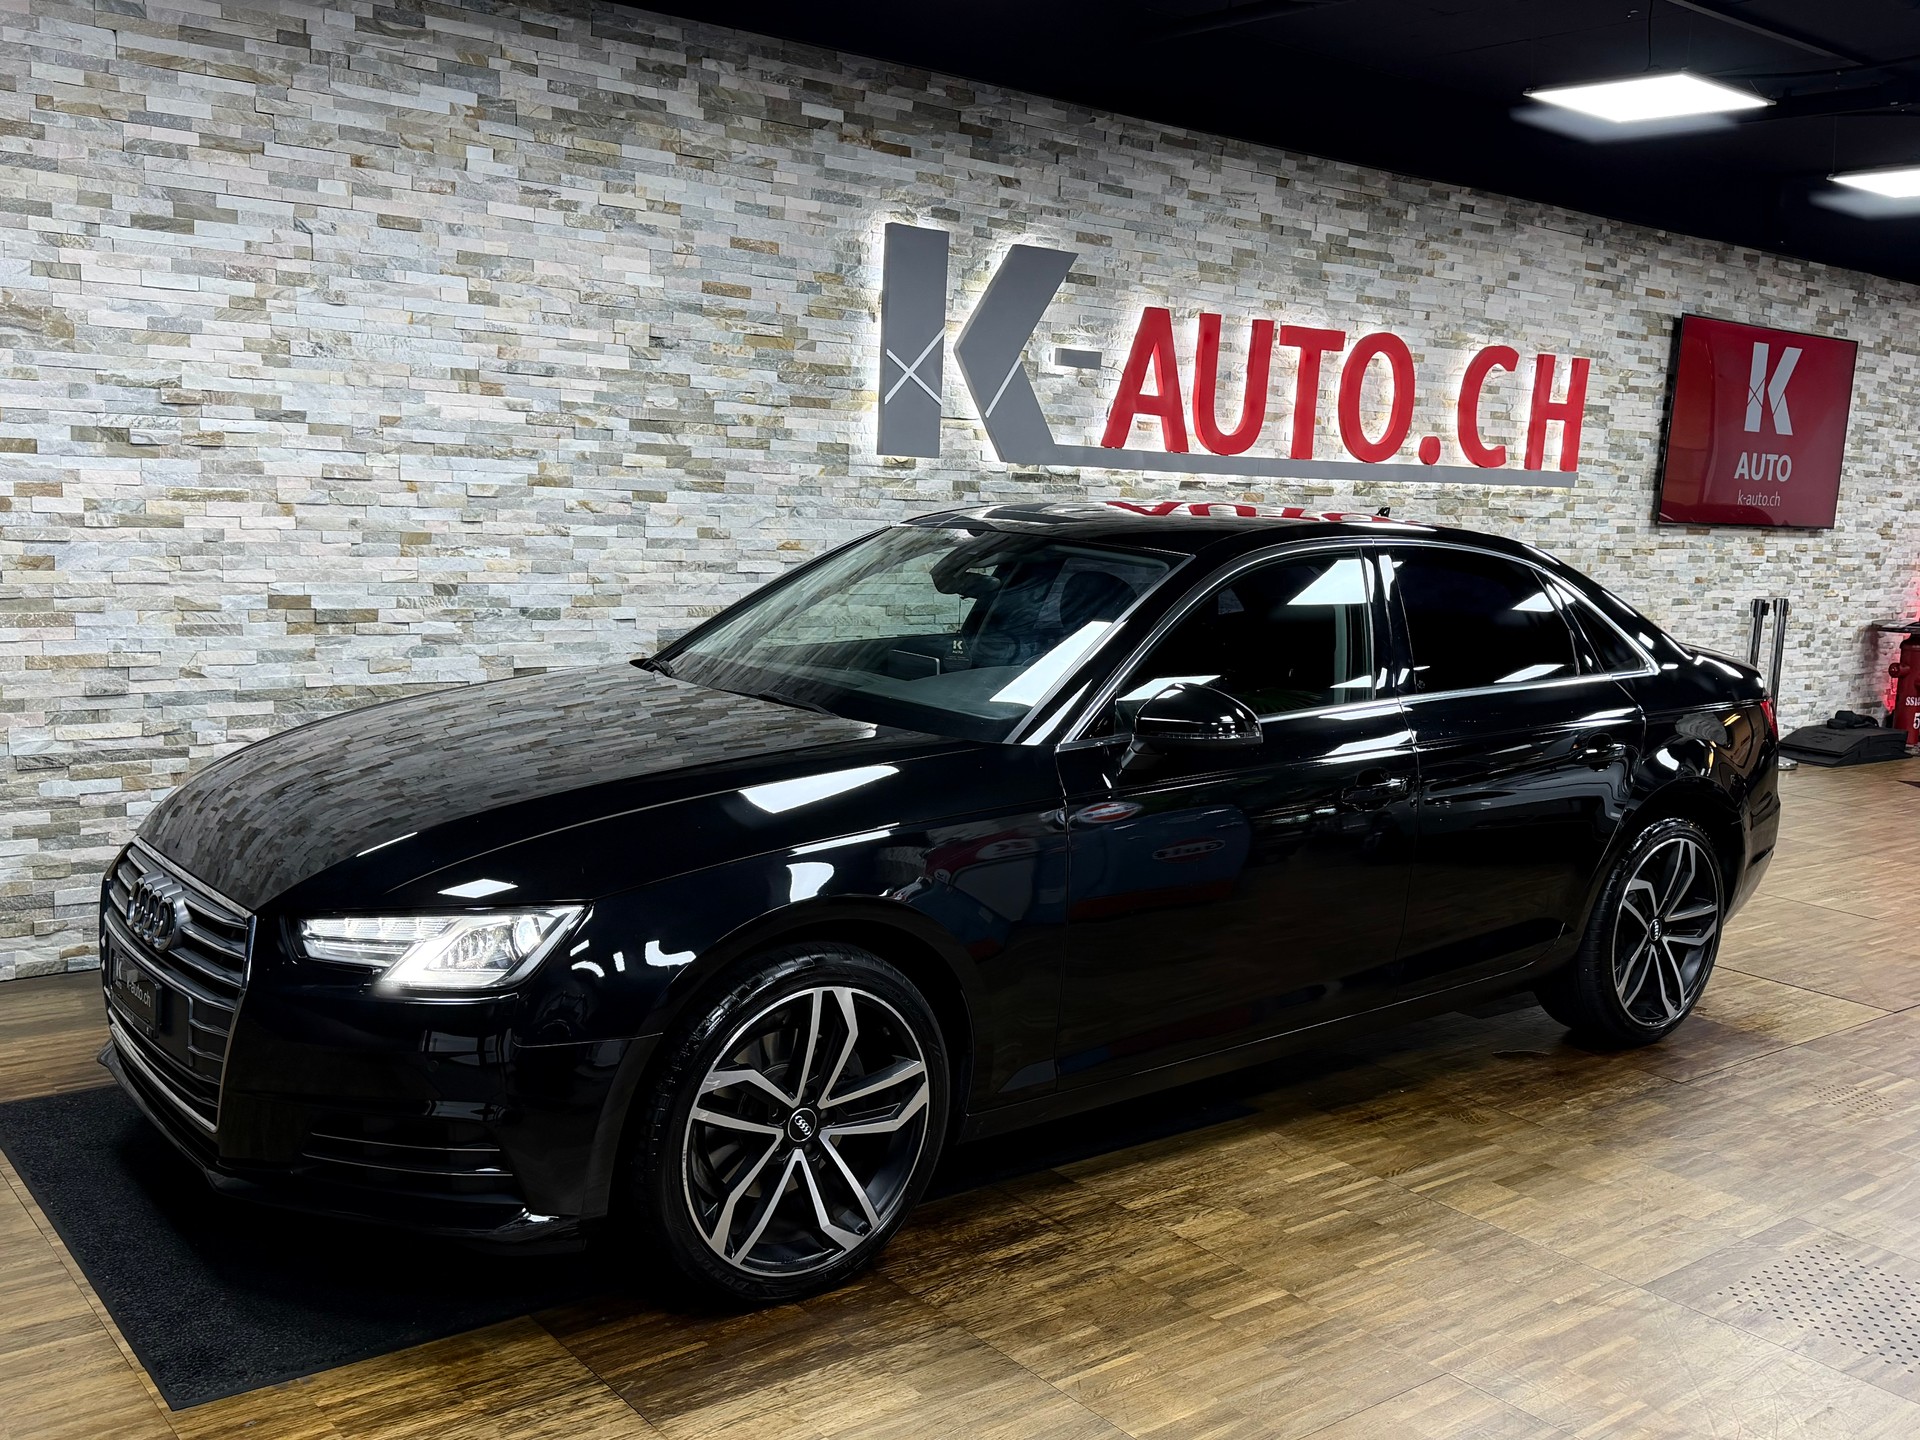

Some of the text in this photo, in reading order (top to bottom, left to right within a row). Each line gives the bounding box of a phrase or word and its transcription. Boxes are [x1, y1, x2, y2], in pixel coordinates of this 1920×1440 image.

[1744, 342, 1803, 436] K
[1734, 452, 1792, 482] AUTO
[1737, 490, 1781, 507] k-auto.ch
